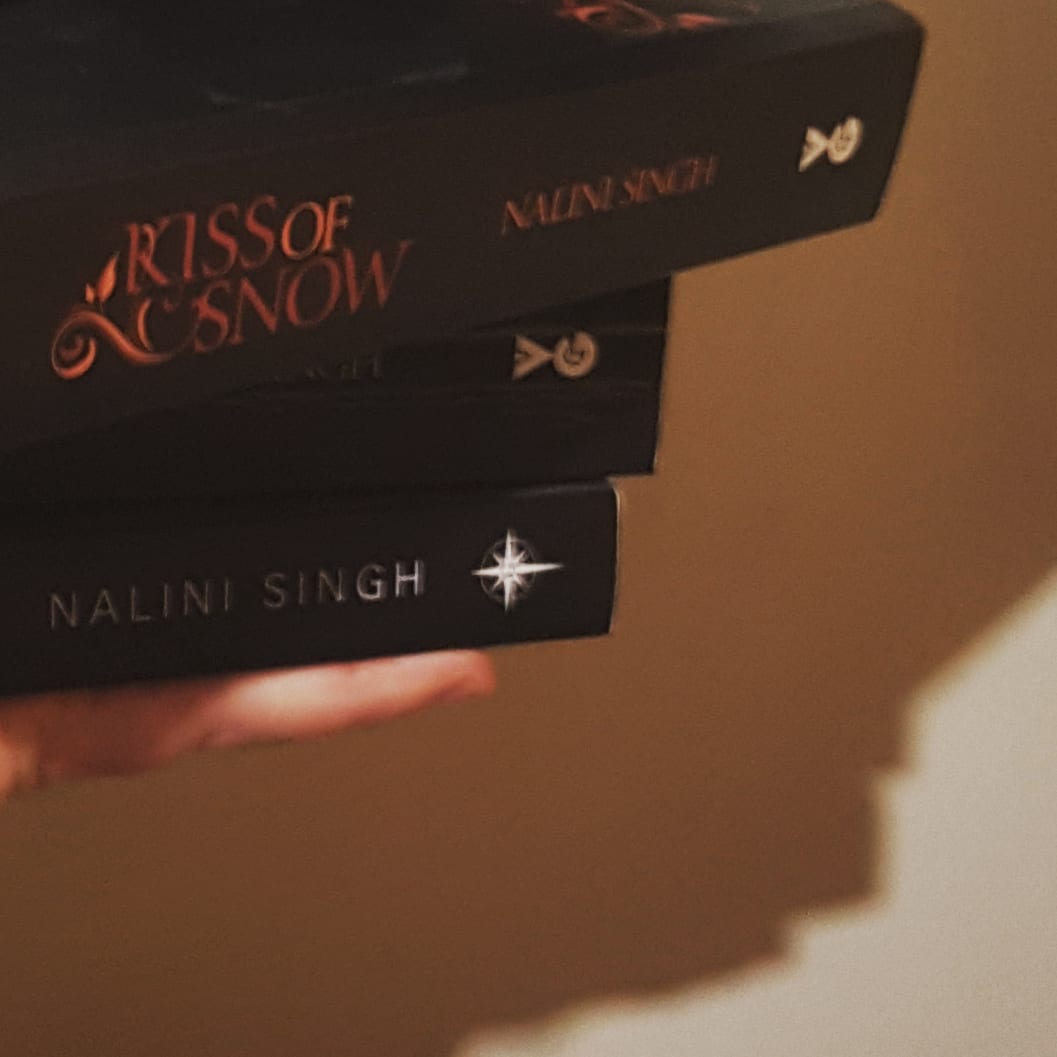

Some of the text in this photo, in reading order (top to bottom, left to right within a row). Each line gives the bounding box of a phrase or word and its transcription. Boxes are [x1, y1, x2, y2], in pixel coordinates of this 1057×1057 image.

[124, 194, 354, 295] KISS OF
[499, 175, 614, 237] NALINI
[192, 238, 414, 354] SNOW
[49, 559, 423, 630] NALINI SINGH
